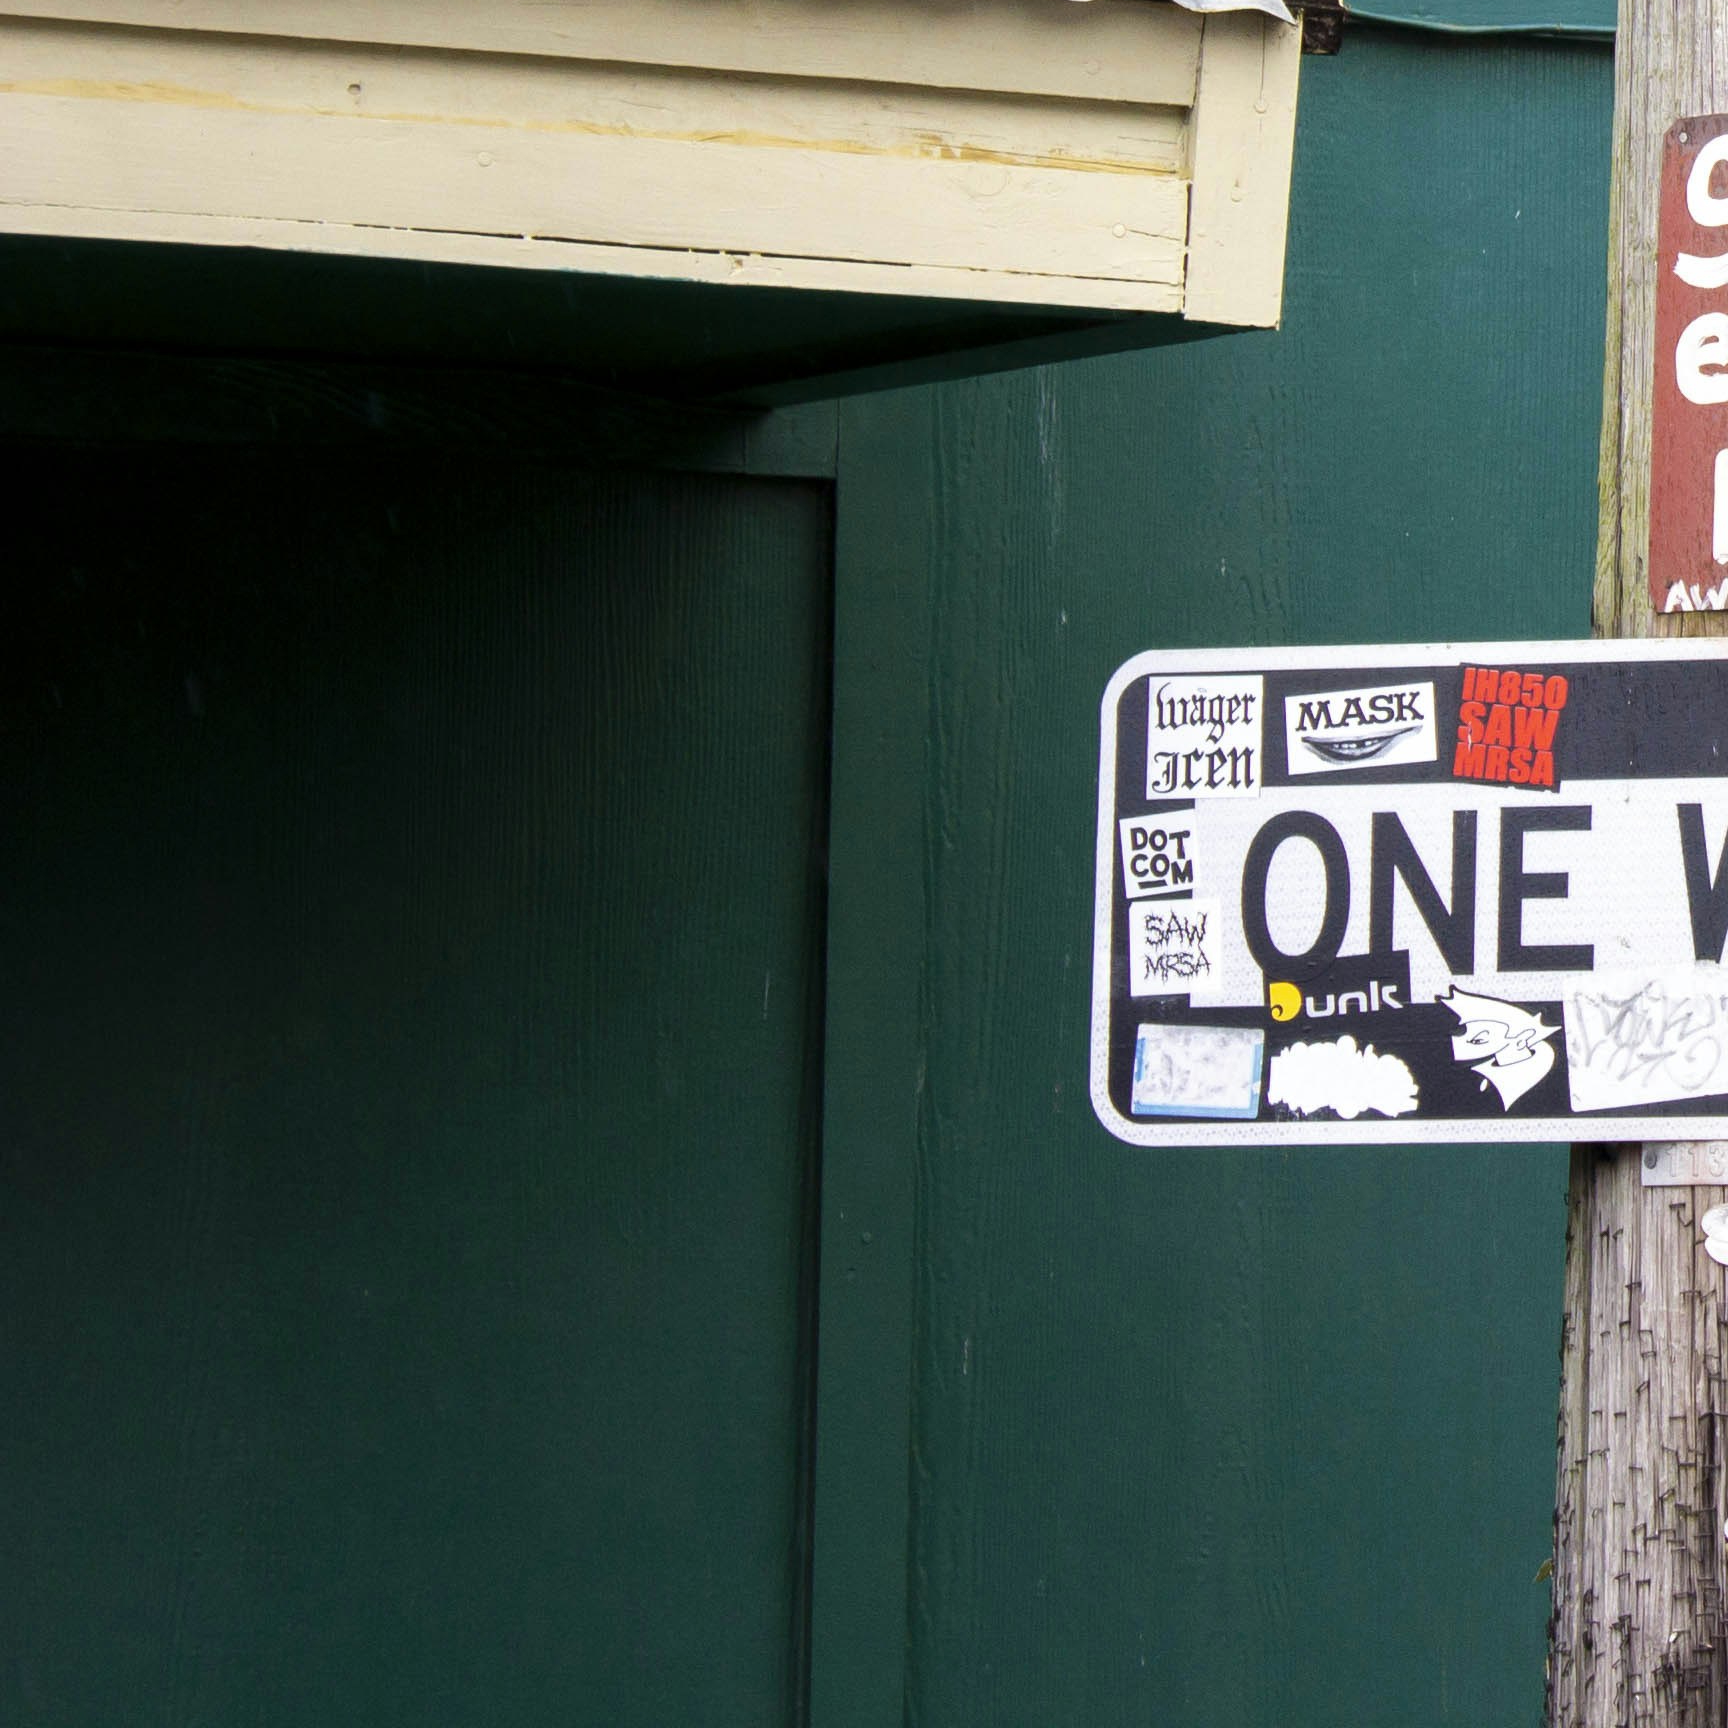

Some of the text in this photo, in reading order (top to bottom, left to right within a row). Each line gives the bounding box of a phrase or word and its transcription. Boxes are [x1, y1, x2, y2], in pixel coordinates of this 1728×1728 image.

[1461, 667, 1568, 710] IH850
[1295, 690, 1425, 732] MASK
[1457, 701, 1560, 751] SAW
[1453, 741, 1554, 786] MRSA
[1130, 826, 1191, 860] DOT
[1130, 853, 1194, 885] COM
[1241, 804, 1595, 976] ONE
[1144, 909, 1208, 948] SAW
[1144, 949, 1212, 983] MRSA
